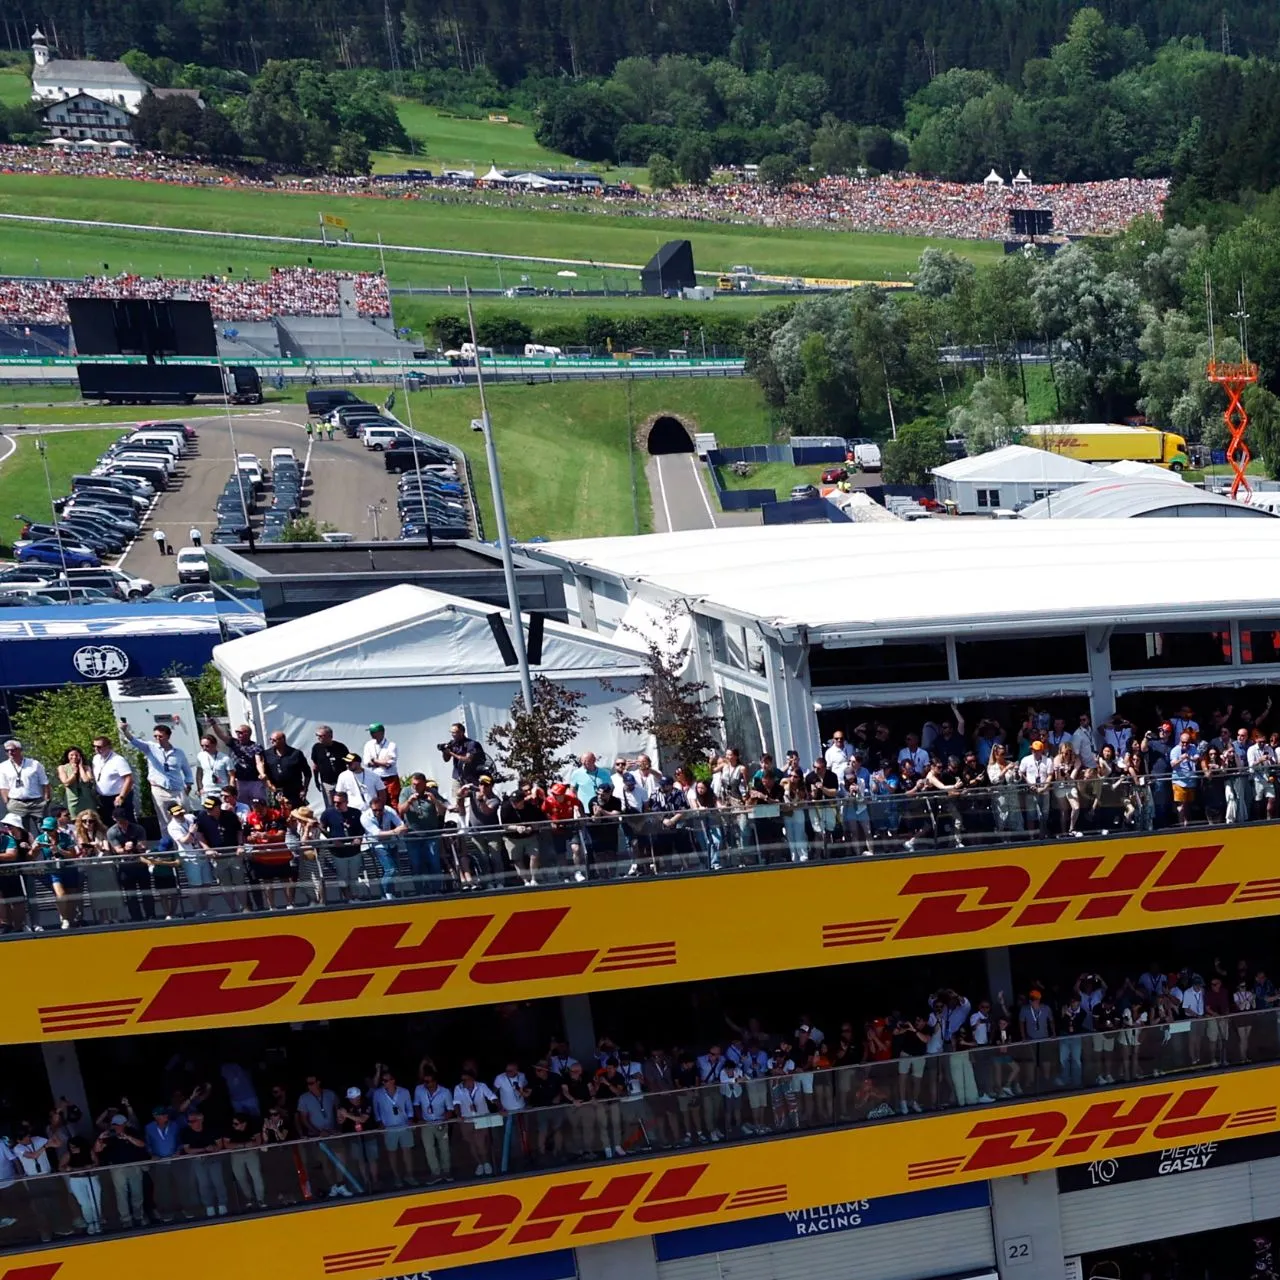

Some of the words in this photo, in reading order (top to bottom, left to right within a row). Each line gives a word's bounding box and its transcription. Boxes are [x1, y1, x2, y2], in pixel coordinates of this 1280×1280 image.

[894, 845, 1239, 939] DHL
[137, 908, 598, 1022] DHL
[962, 1087, 1230, 1171] DHL
[1160, 1142, 1218, 1161] PIERRE
[1158, 1154, 1212, 1175] GASLY
[395, 1164, 729, 1262] DHL
[785, 1199, 870, 1223] WILLIAMS
[796, 1214, 862, 1234] RACING
[1008, 1243, 1029, 1259] 22
